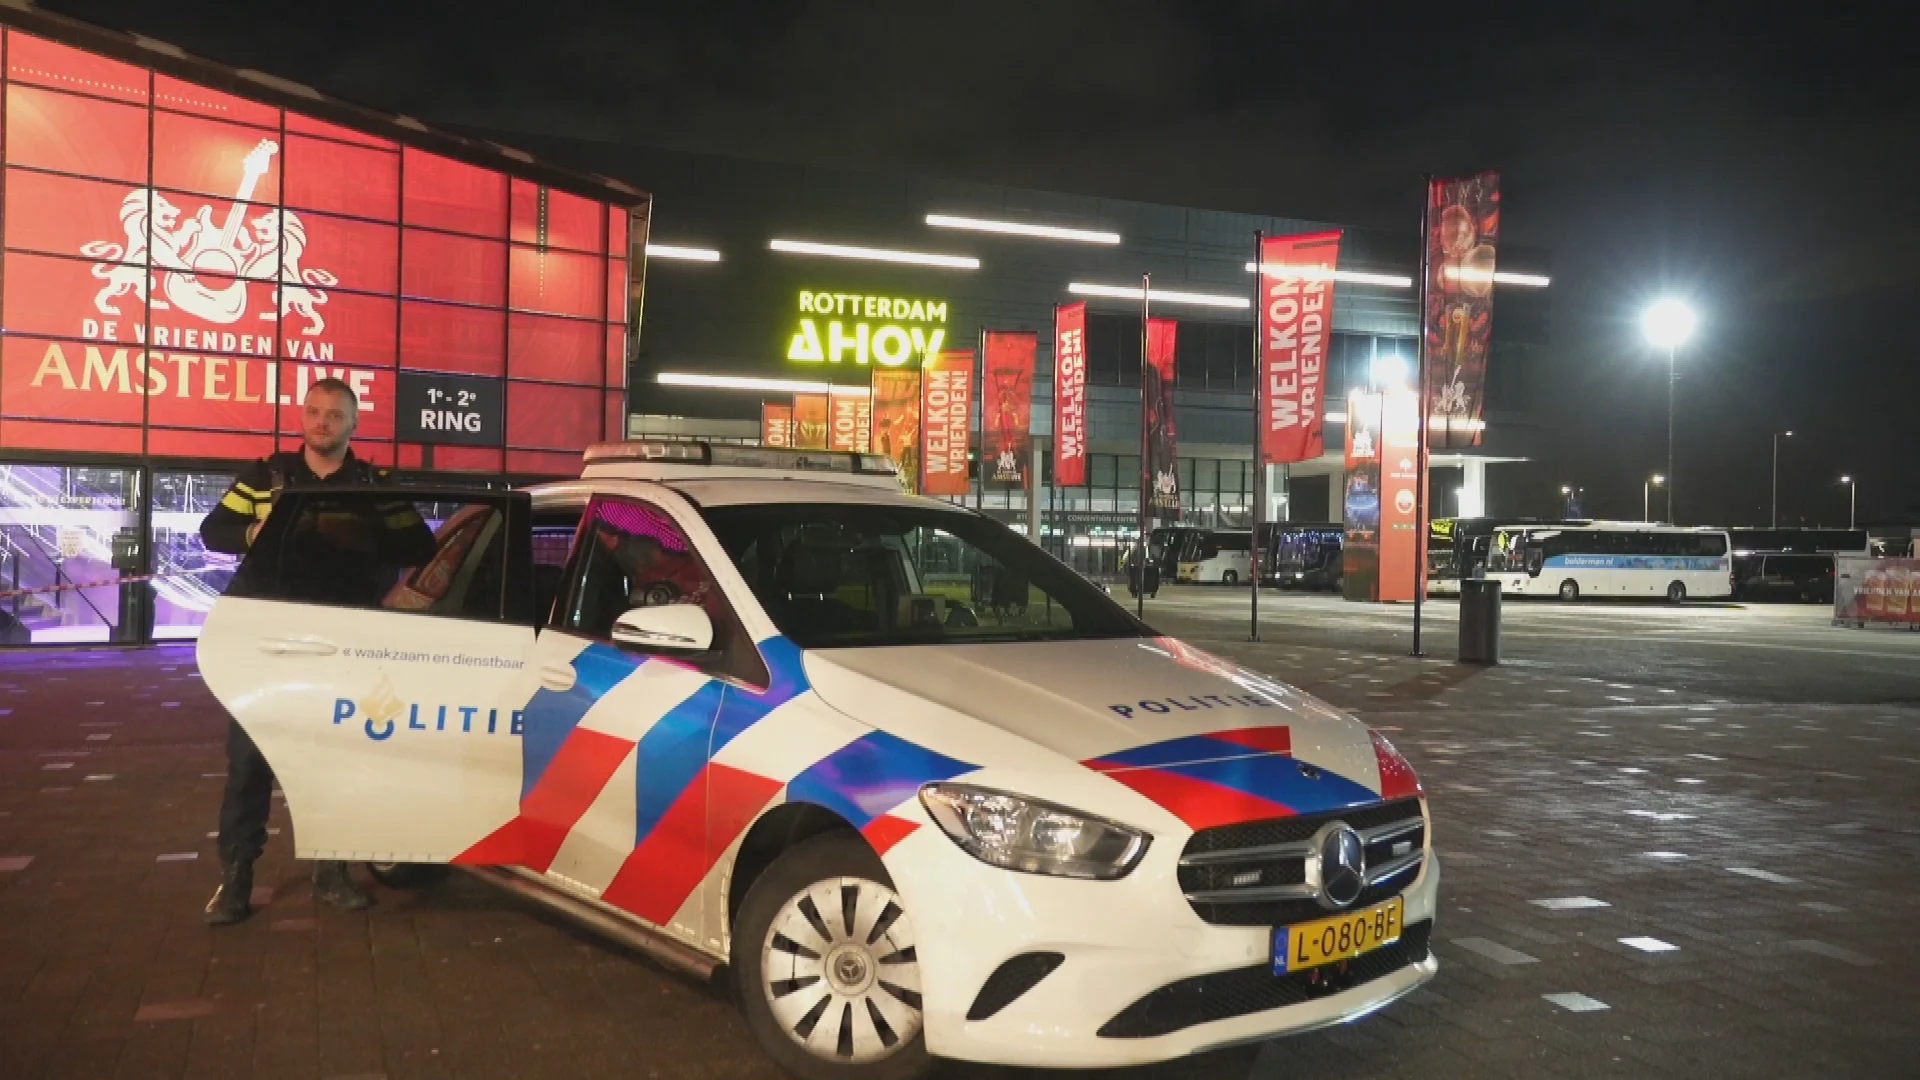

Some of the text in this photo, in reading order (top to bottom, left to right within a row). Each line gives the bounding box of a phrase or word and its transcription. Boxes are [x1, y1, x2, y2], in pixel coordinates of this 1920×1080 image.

[799, 290, 947, 323] ROTTERDAM
[82, 318, 335, 362] DE VRIENDEN VAN
[1060, 330, 1077, 460] WELKOM
[420, 408, 482, 432] RING
[926, 370, 950, 474] WELKOM
[949, 370, 969, 474] VRIENDEN!
[354, 647, 431, 664] waakzaam
[432, 653, 451, 665] en
[452, 653, 525, 670] dienstbaar
[1108, 695, 1272, 719] POLITIE
[1297, 903, 1397, 963] L-080-BF
[1274, 955, 1286, 967] NL
